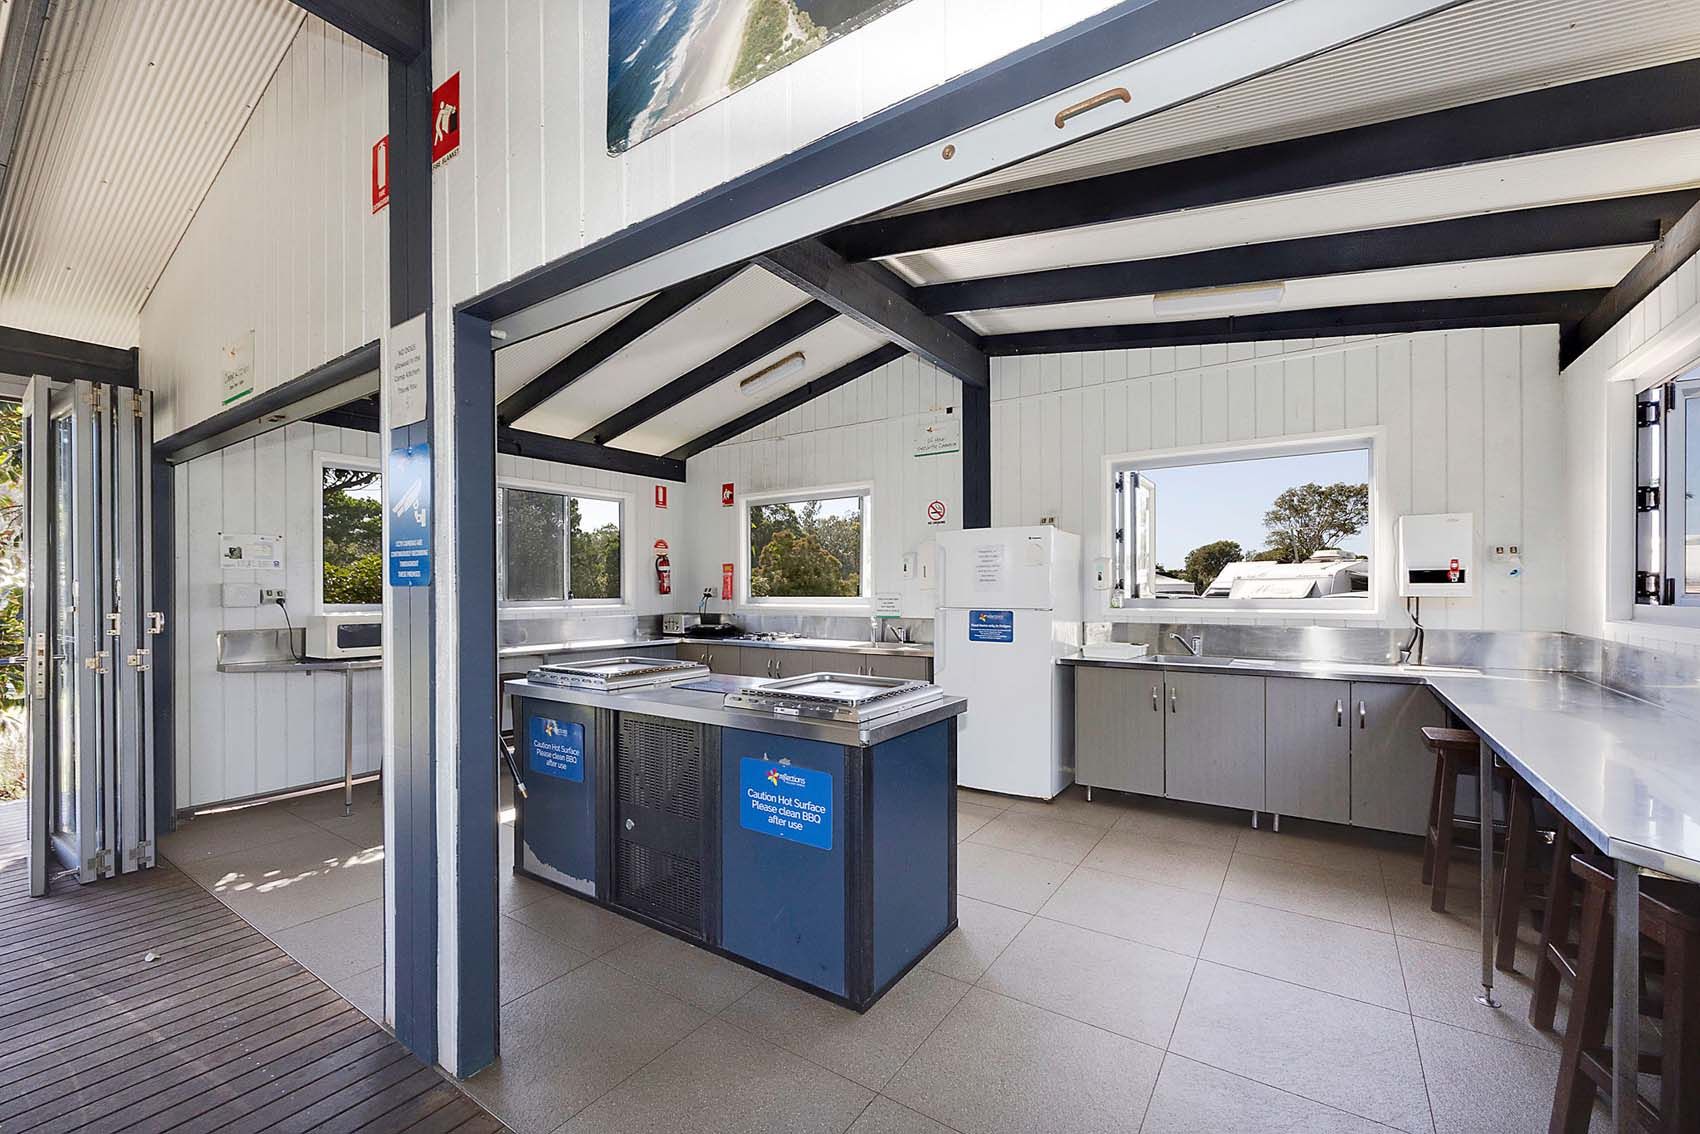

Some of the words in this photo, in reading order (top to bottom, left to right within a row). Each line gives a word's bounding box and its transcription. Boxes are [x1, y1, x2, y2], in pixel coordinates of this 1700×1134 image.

[534, 740, 551, 750] Caution
[561, 746, 580, 756] Surface
[536, 749, 552, 757] Please
[552, 753, 565, 761] clean
[566, 755, 577, 764] BBQ
[748, 788, 776, 803] Caution
[778, 795, 792, 806] Hot
[794, 799, 826, 814] Surface
[752, 800, 777, 813] Please
[778, 807, 800, 819] clean
[802, 813, 821, 824] BBQ
[768, 815, 786, 826] after
[788, 821, 803, 831] use
